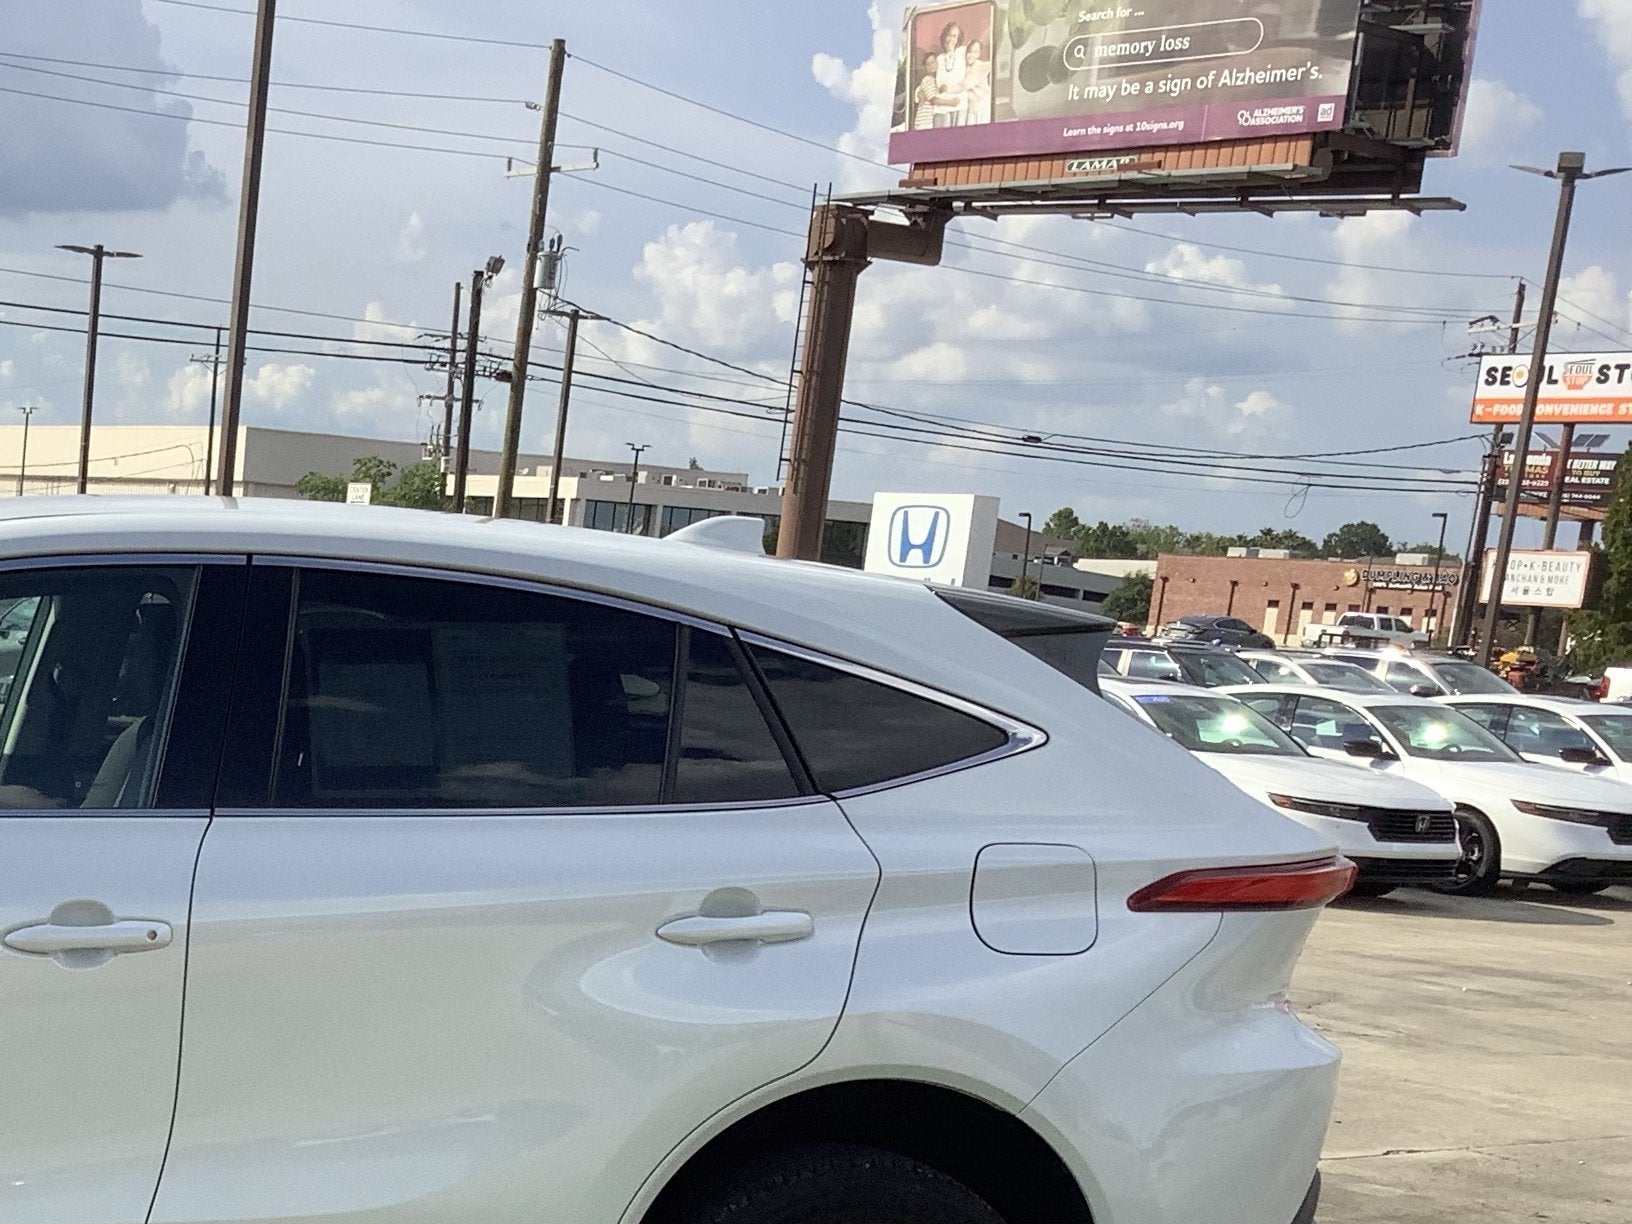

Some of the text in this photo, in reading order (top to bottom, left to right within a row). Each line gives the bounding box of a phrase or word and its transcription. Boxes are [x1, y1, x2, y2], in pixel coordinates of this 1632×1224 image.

[1078, 8, 1114, 22] Search
[1115, 6, 1133, 19] for
[1094, 34, 1191, 57] memory loss
[1068, 61, 1323, 103] It may be a sign of Alzheimer's.
[1249, 114, 1304, 127] ASSOCIATION
[1063, 127, 1086, 138] Learn
[1087, 124, 1102, 135] the
[1103, 123, 1124, 136] signs
[1125, 123, 1134, 132] at
[1536, 402, 1615, 416] ONVENIENCE
